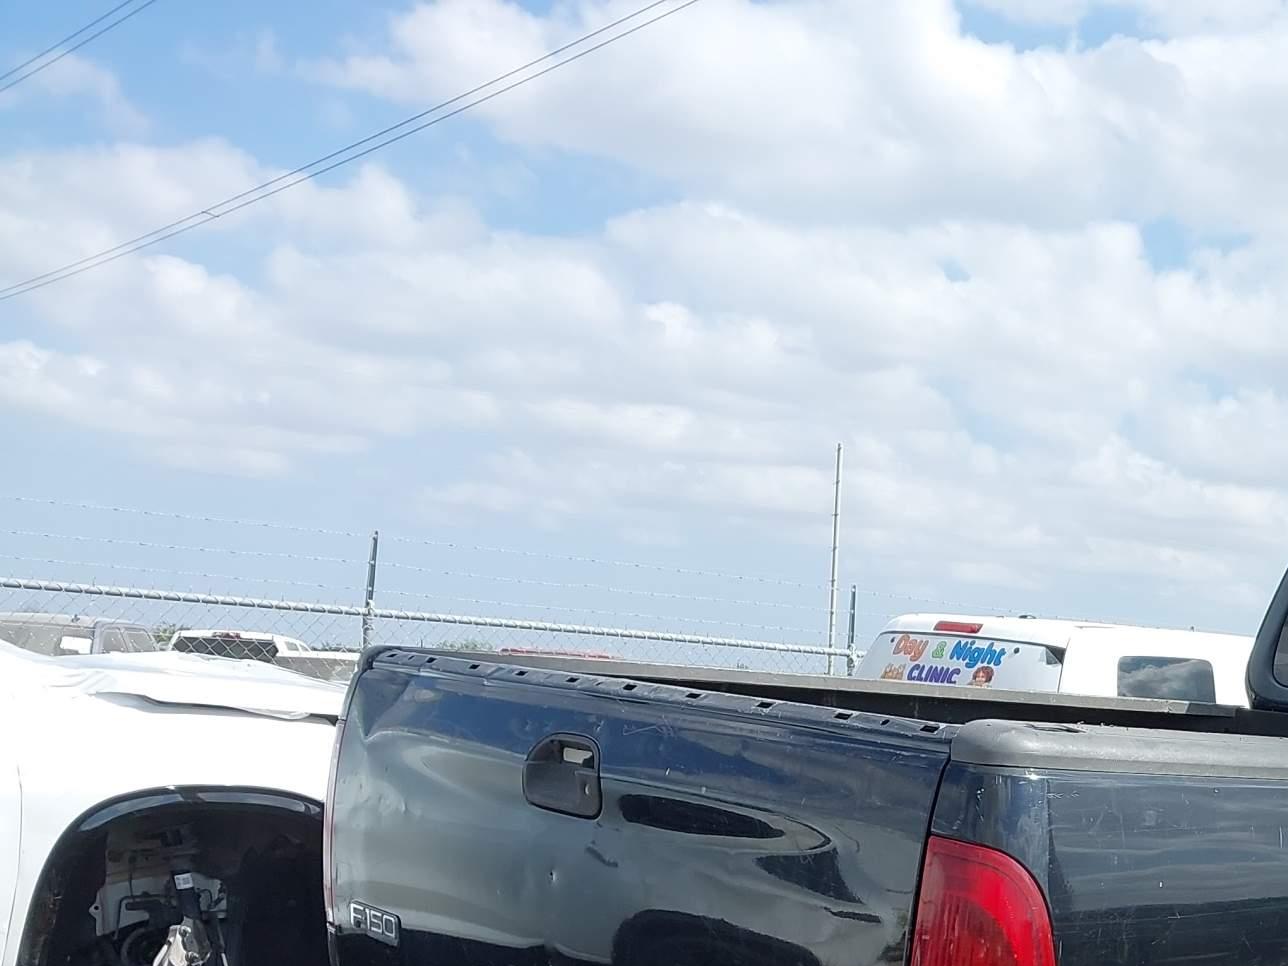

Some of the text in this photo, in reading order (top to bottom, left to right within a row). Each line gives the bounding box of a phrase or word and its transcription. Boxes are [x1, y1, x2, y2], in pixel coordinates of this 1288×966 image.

[893, 634, 1006, 668] Day & Night
[907, 663, 961, 684] CLINIC
[351, 903, 396, 938] F150
